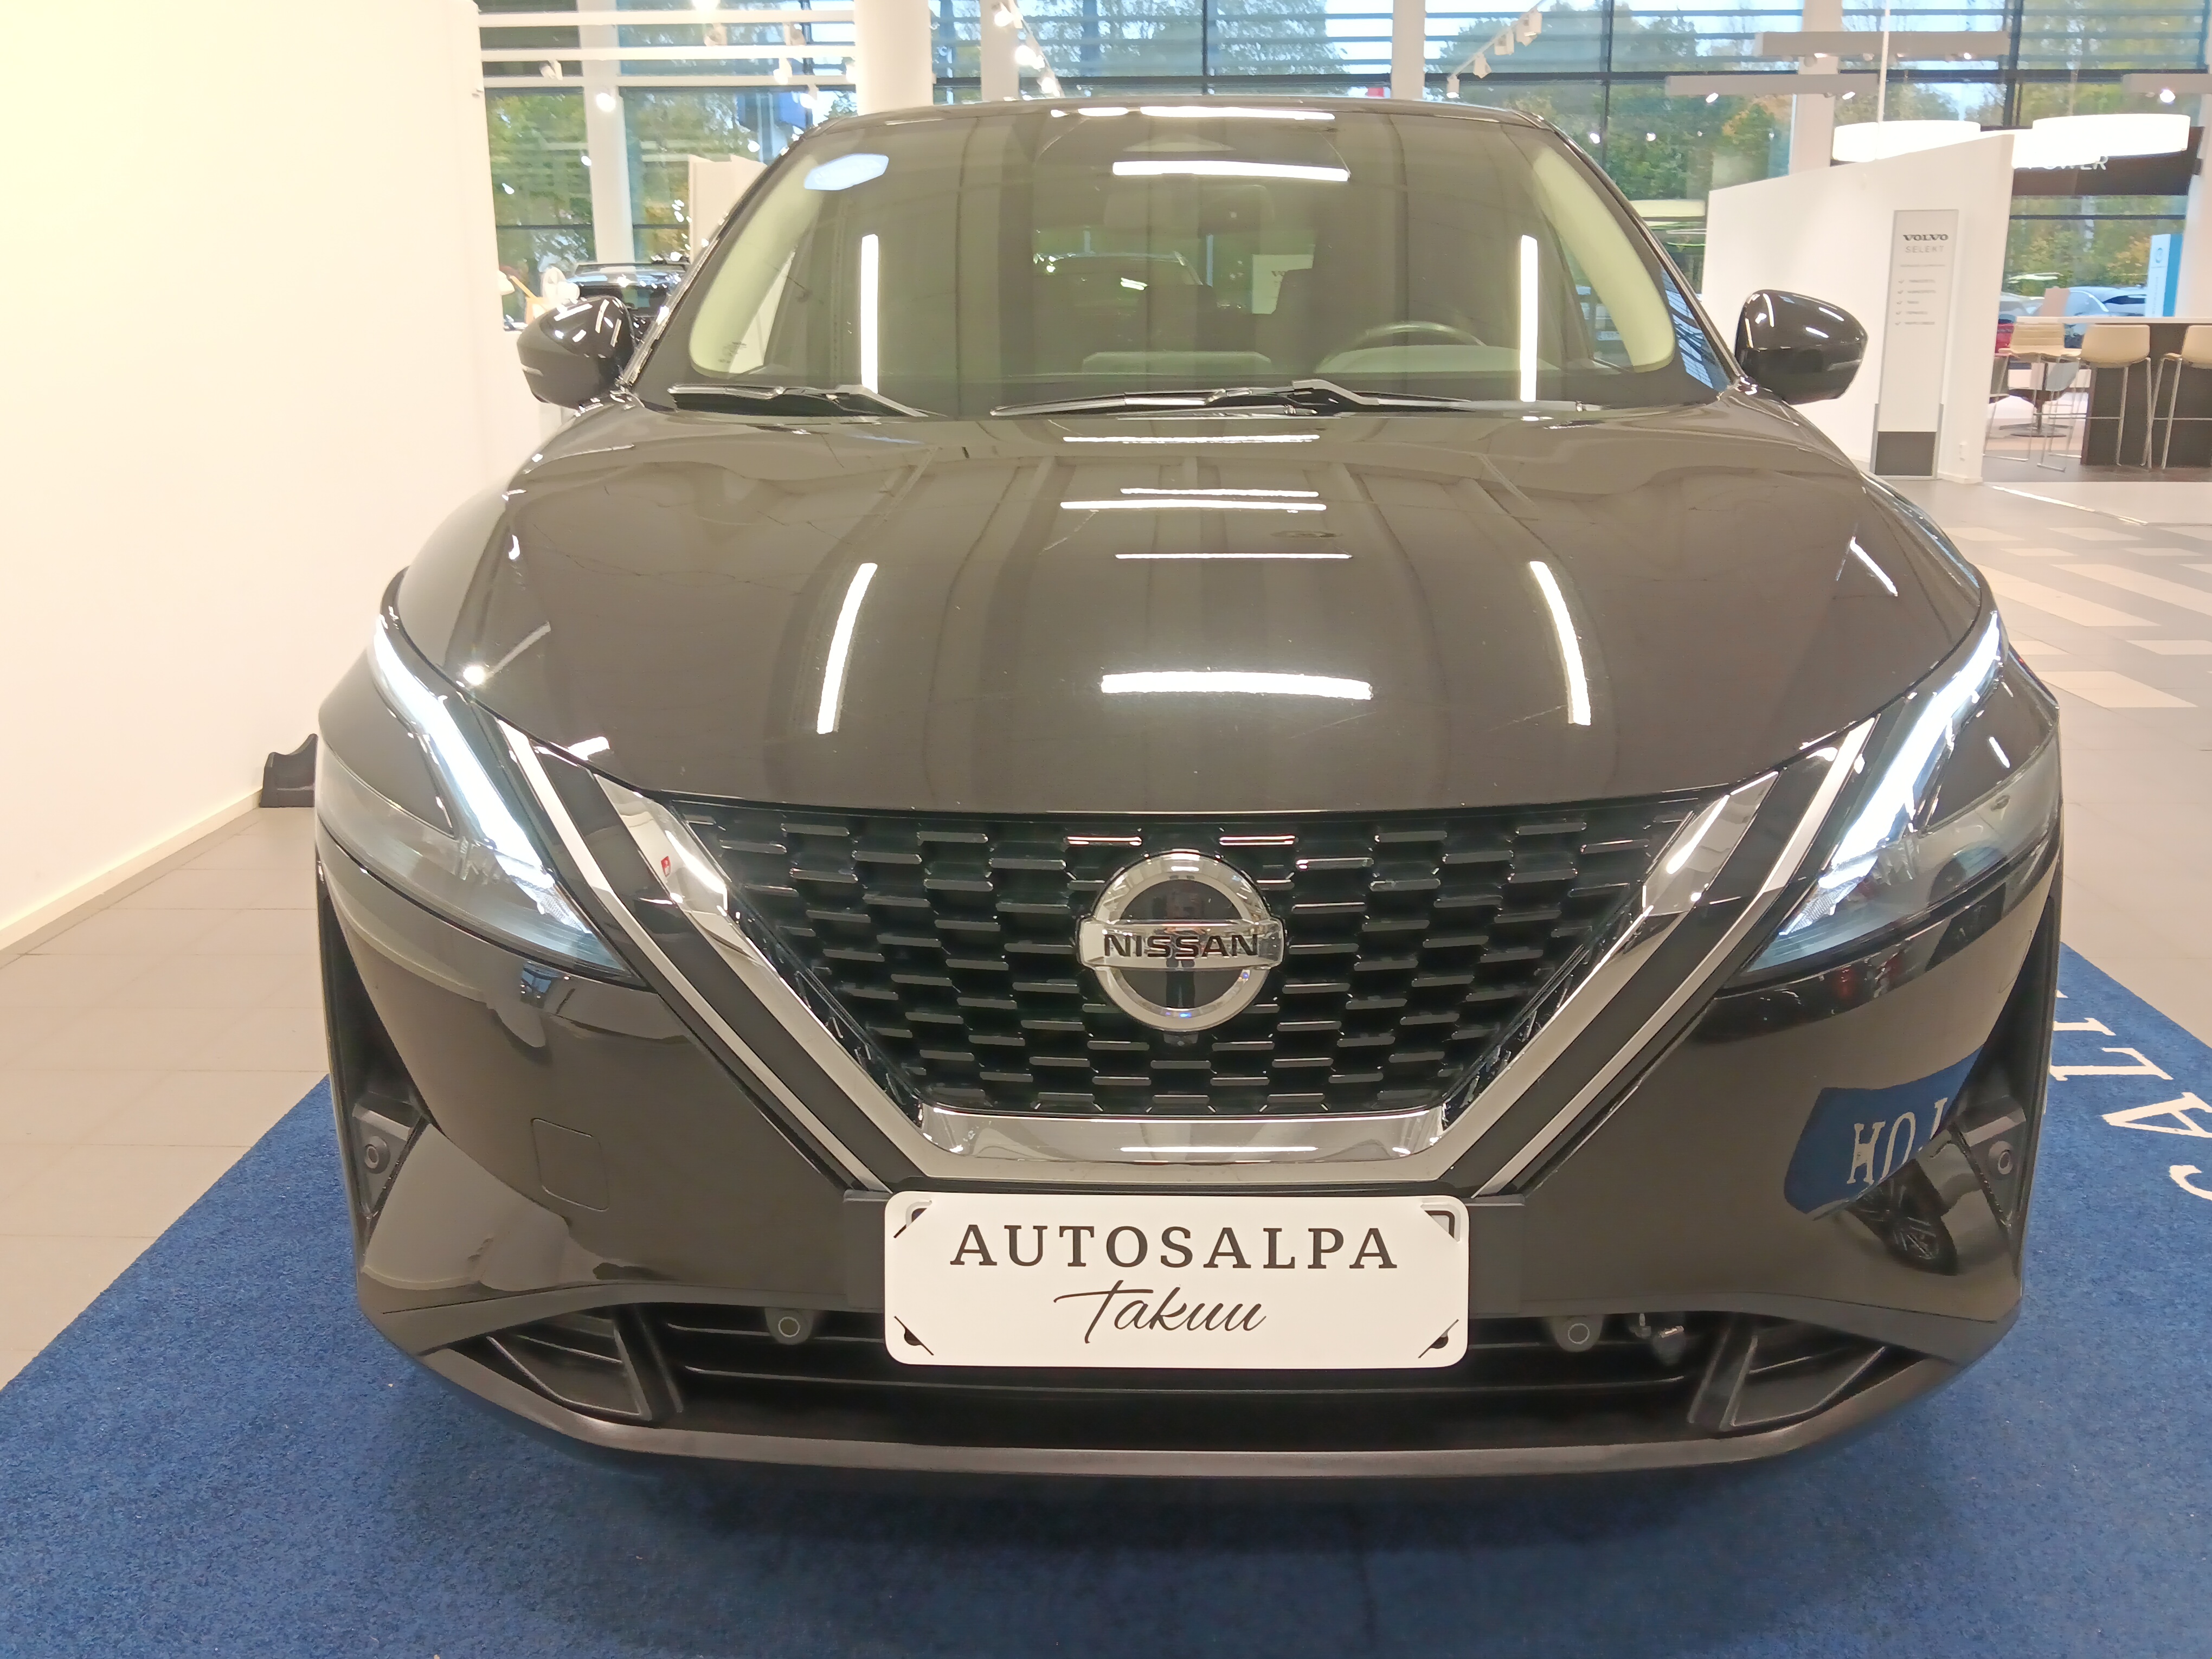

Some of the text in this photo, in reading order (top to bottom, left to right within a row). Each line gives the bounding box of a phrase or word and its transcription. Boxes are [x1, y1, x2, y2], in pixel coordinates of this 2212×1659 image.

[1905, 245, 1945, 253] SELEKT
[1103, 933, 1259, 960] NISSAN
[949, 1224, 1398, 1270] AUTOSALPA
[1053, 1279, 1267, 1344] Takuu
